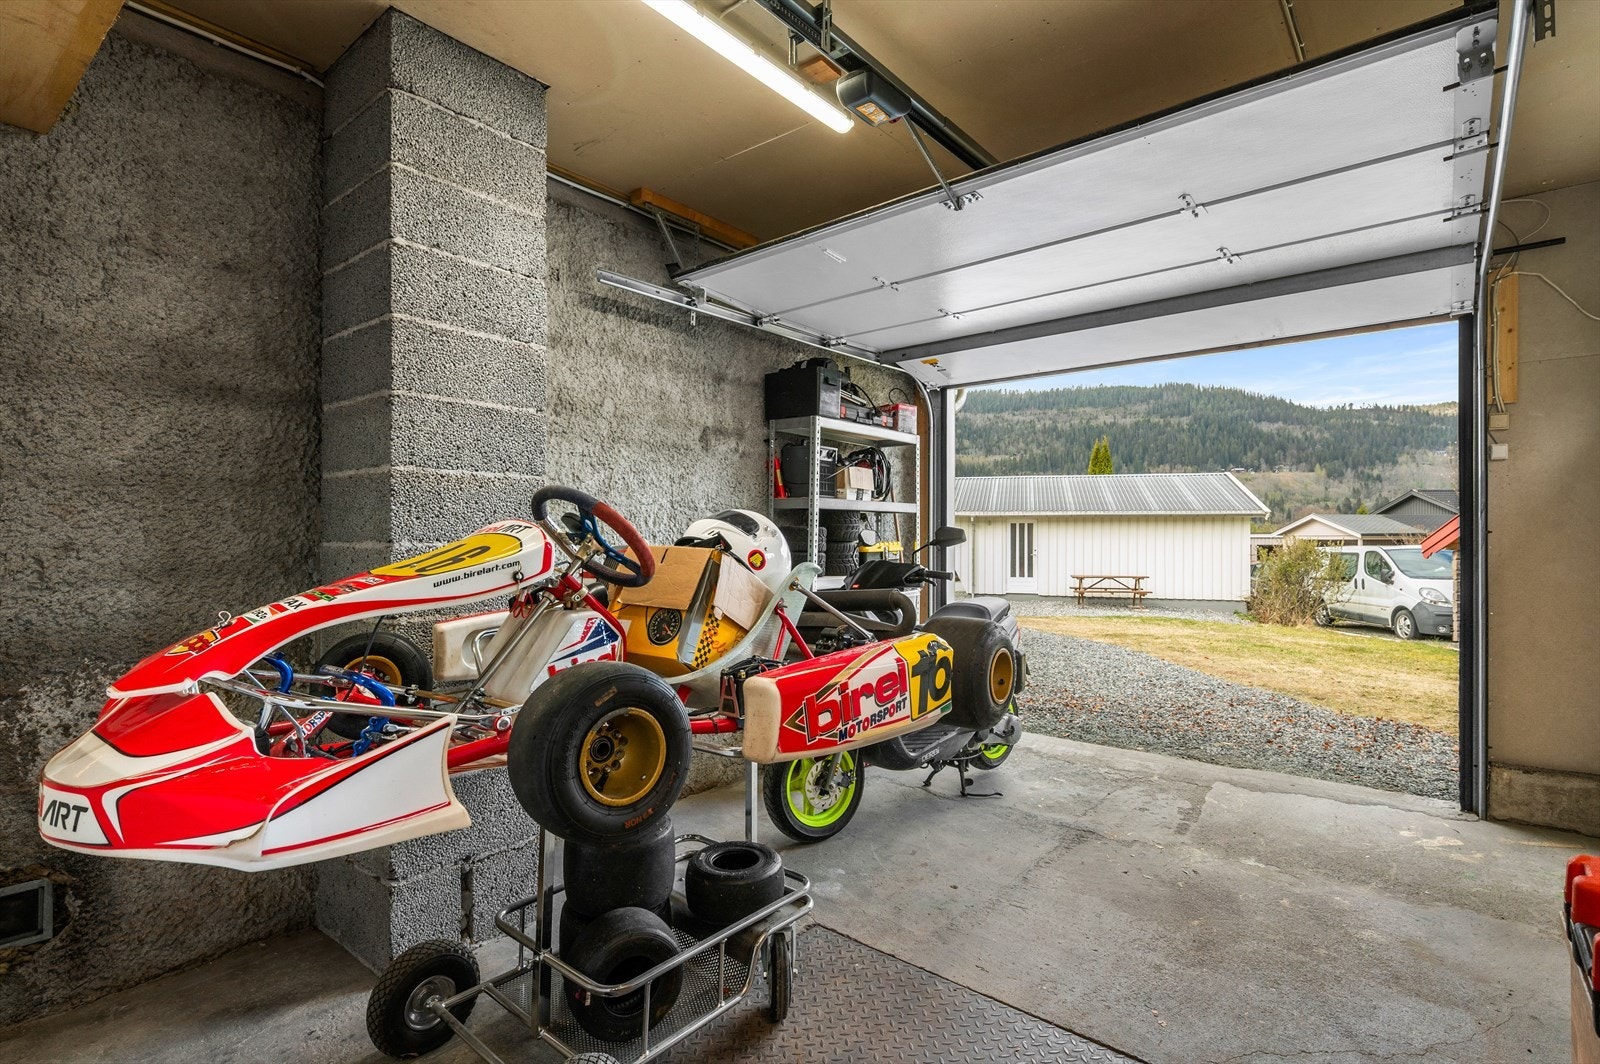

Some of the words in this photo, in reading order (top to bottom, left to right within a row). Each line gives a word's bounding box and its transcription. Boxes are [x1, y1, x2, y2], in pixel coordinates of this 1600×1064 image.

[433, 560, 520, 588] www.birelart.com
[804, 656, 908, 743] birel
[838, 697, 908, 742] MOTORSPORT
